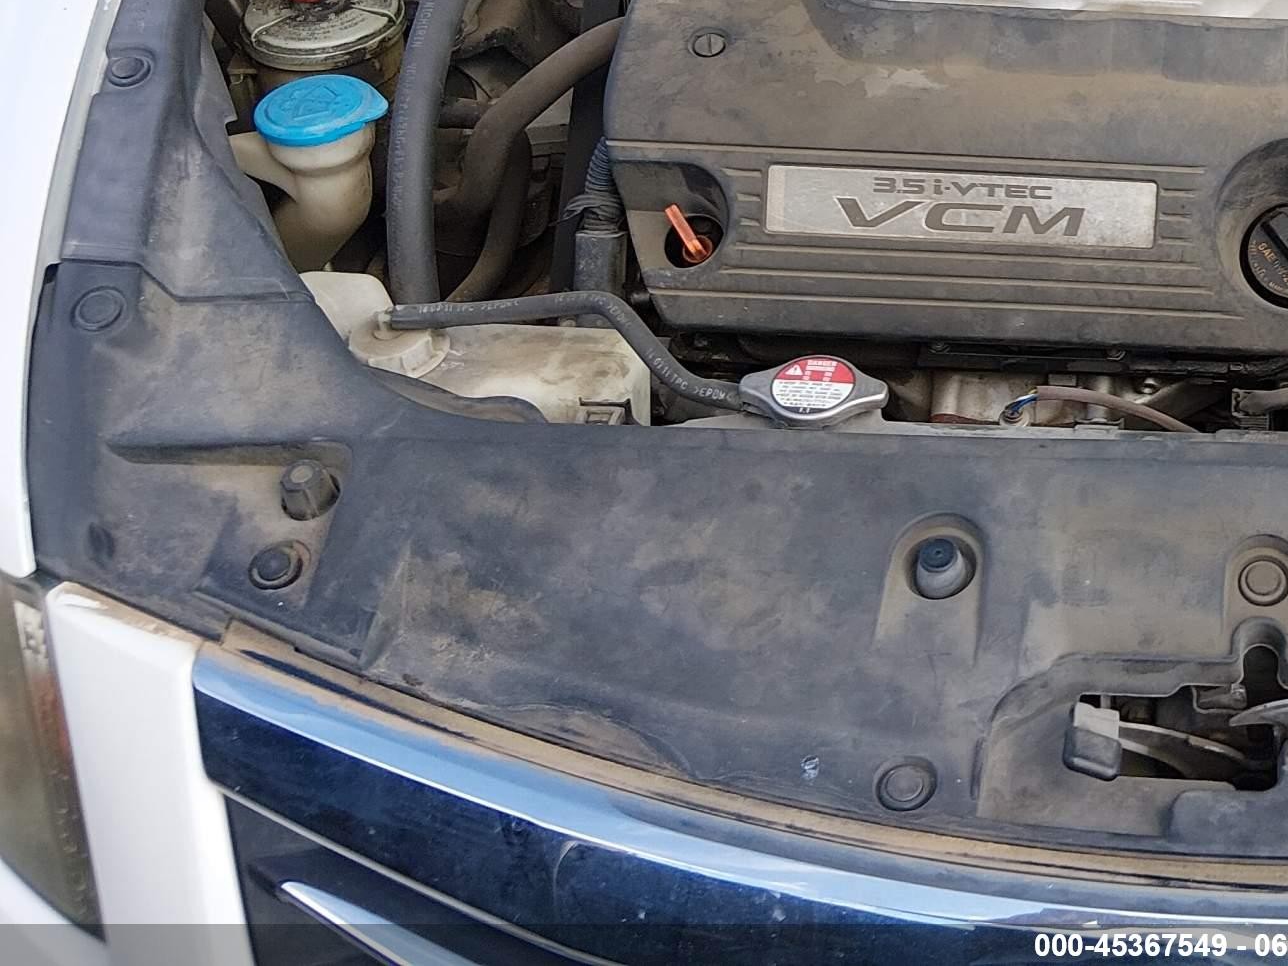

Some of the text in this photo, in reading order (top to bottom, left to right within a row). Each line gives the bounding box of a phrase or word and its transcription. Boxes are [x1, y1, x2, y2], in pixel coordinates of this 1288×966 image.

[873, 177, 1053, 199] 3.5 i-VTEC
[835, 196, 1085, 236] VCM
[1258, 242, 1274, 262] SAE
